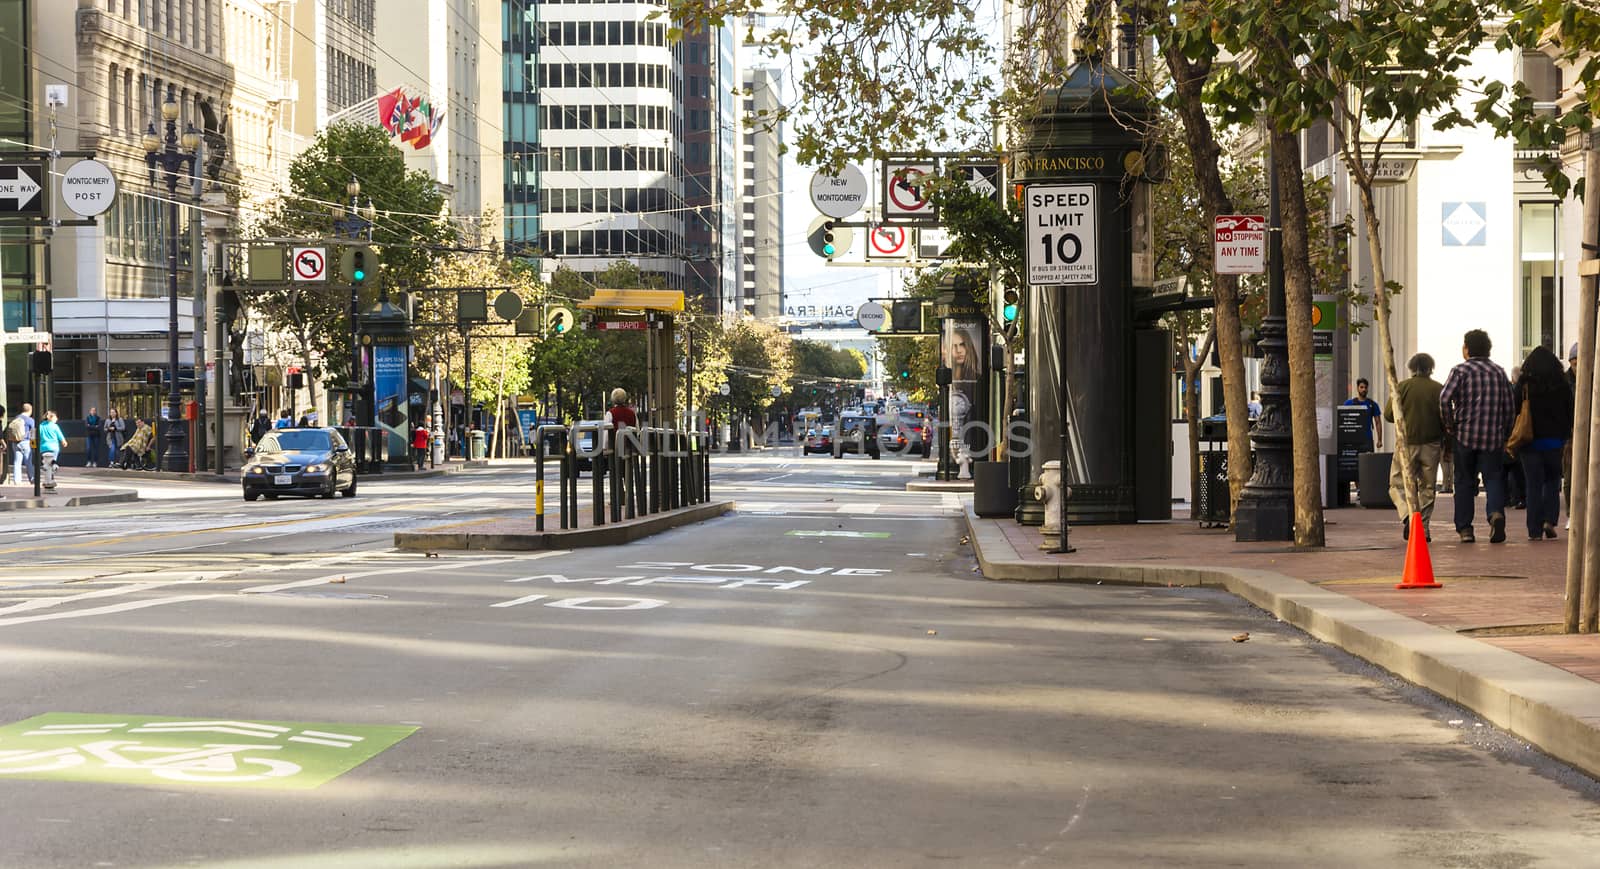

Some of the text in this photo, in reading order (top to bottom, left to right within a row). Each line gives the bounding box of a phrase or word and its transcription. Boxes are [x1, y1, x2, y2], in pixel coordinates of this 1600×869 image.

[1036, 157, 1105, 171] FRANCISCO
[67, 177, 110, 185] MONTGOMERY
[817, 193, 861, 201] MONTGOMERY
[1033, 194, 1089, 207] SPEED
[1039, 213, 1084, 227] LIMIT
[1217, 232, 1232, 240] NO
[1042, 233, 1082, 264] 10
[1221, 247, 1259, 256] ANY TIME
[616, 561, 892, 577] ZONE
[504, 574, 812, 591] MPH
[489, 594, 670, 611] 10
